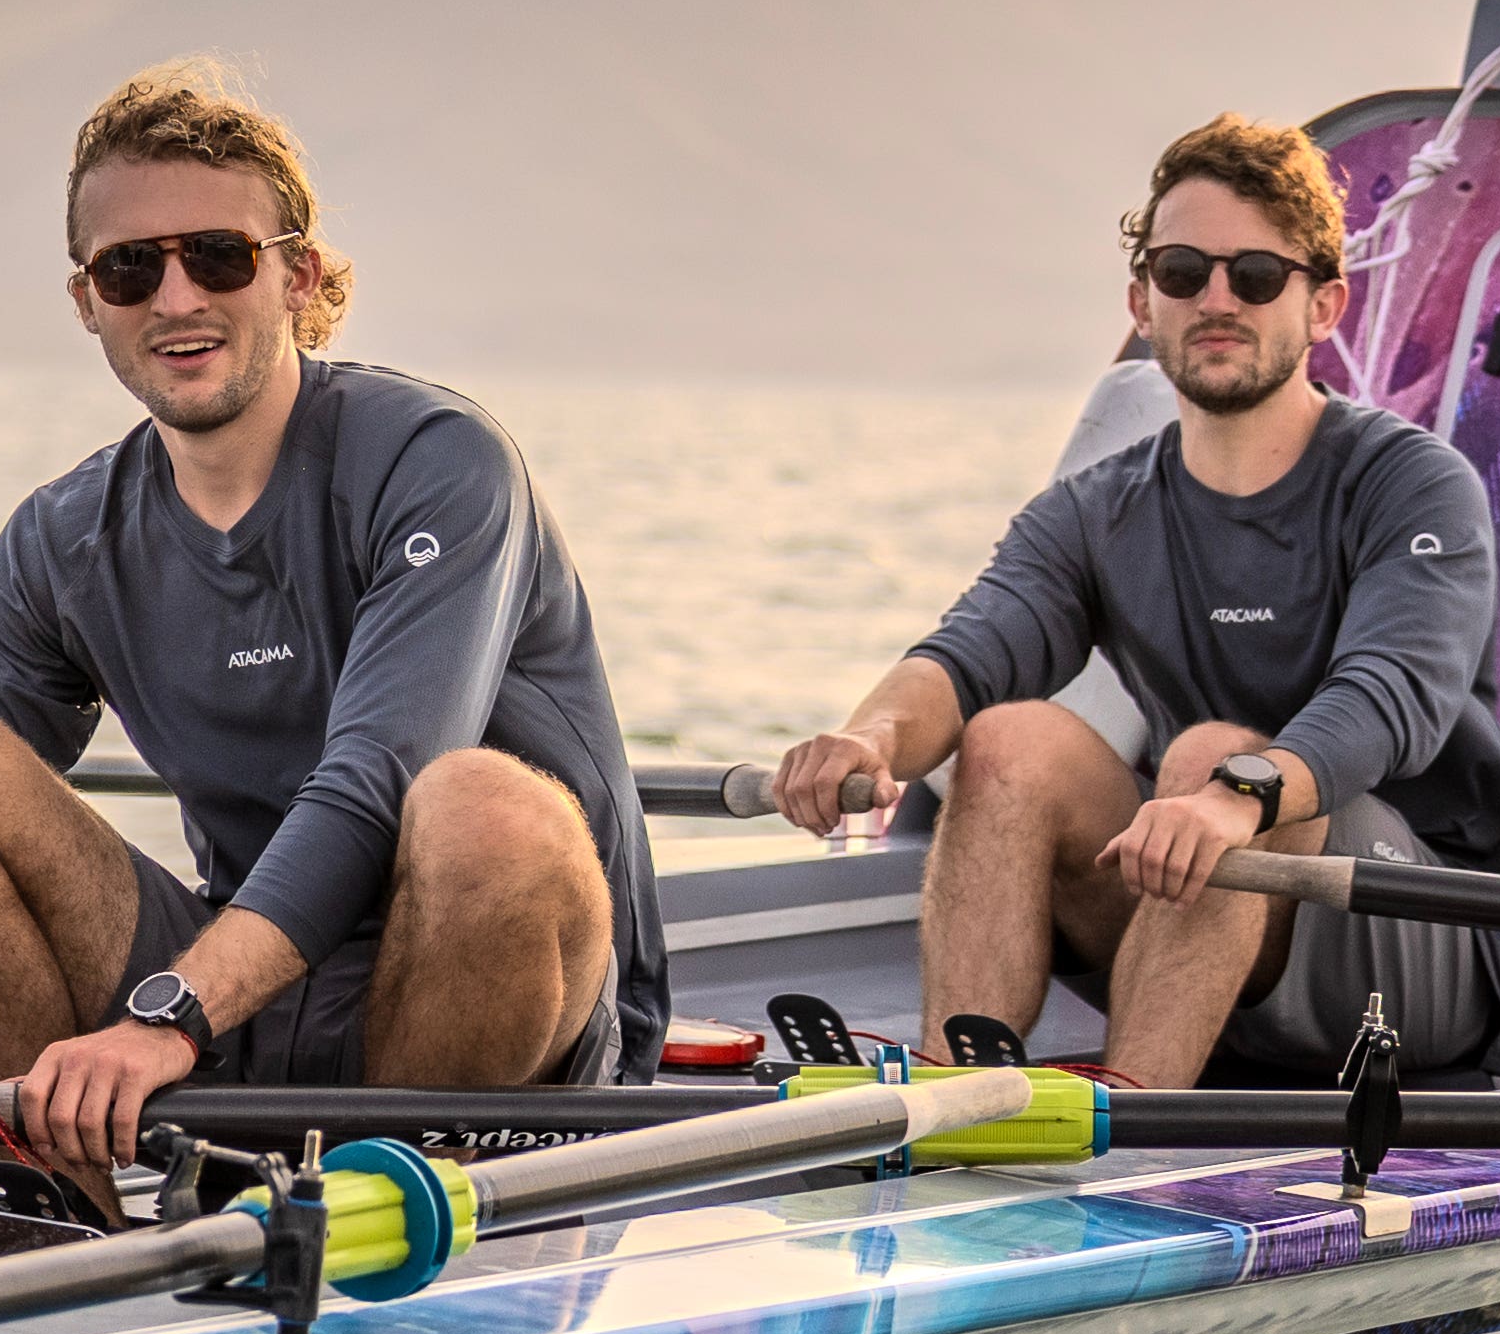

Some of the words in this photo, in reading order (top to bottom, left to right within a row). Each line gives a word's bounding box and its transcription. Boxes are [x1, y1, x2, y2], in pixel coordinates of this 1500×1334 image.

[1209, 607, 1276, 623] ATACAMA
[228, 643, 294, 669] ATACAMA
[421, 1130, 448, 1149] 2
